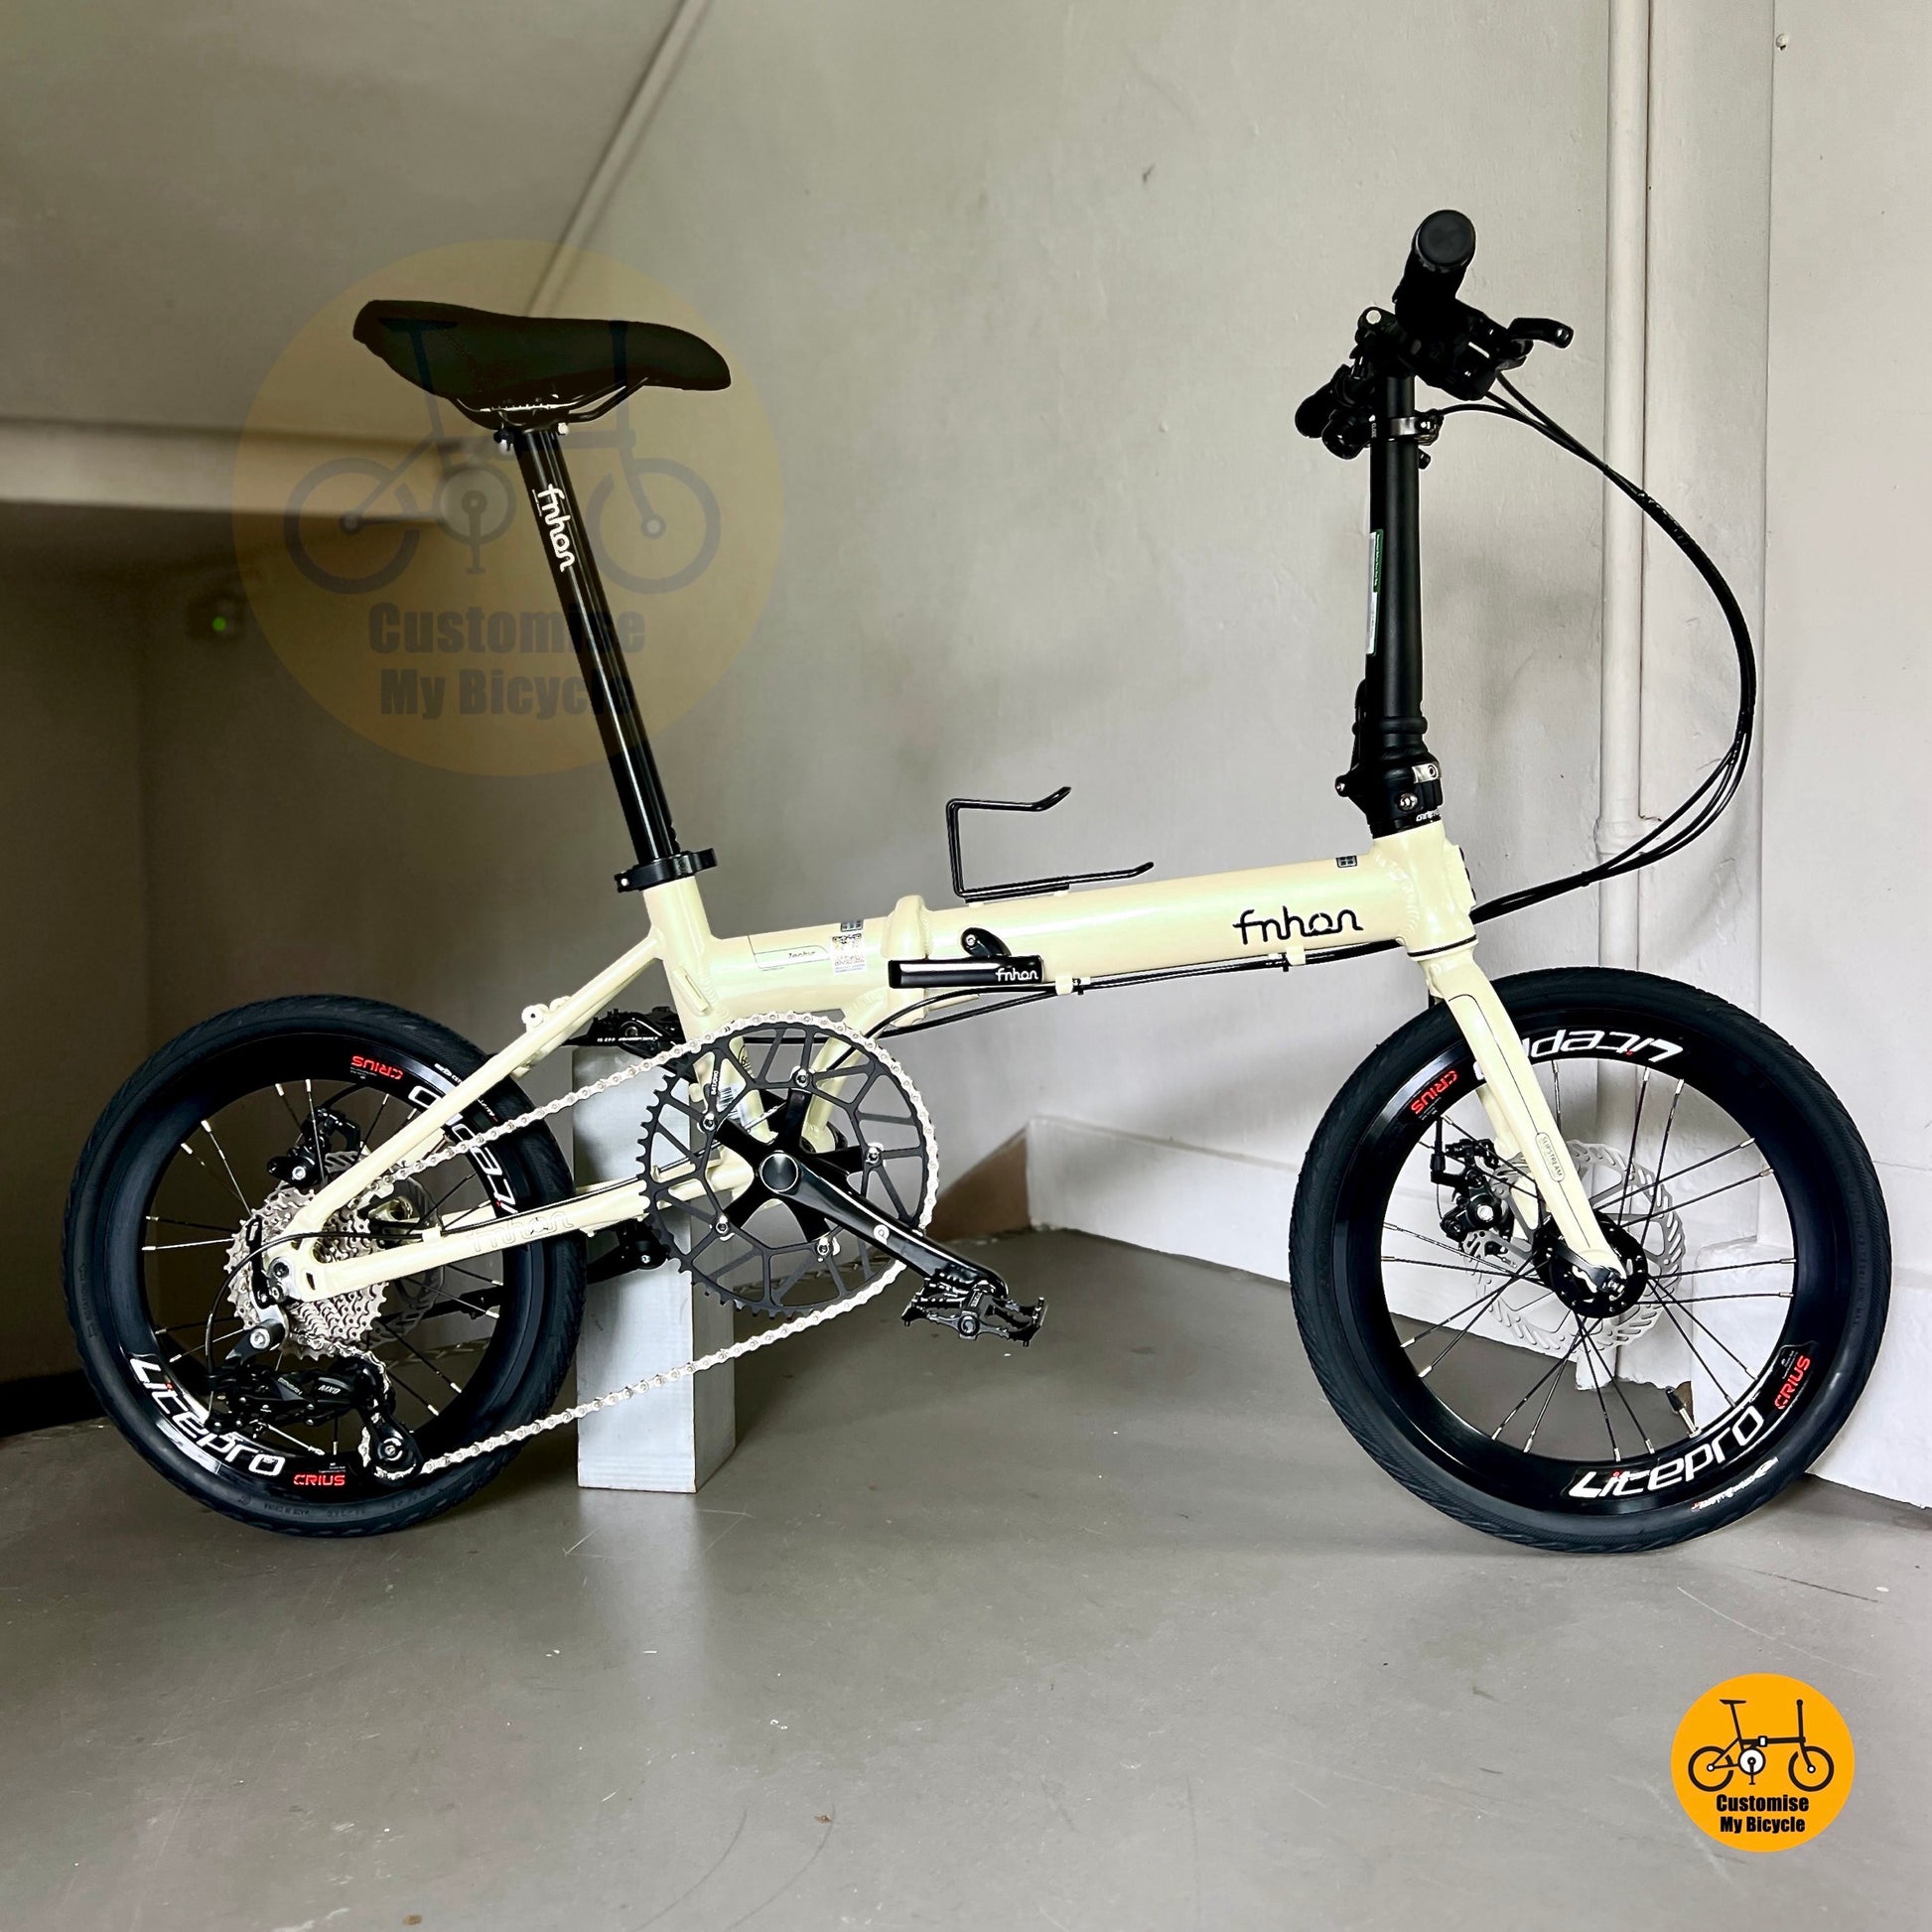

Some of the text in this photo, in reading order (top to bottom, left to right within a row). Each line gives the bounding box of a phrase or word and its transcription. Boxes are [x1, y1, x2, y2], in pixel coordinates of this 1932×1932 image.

[1233, 905, 1364, 945] fnhon
[351, 1055, 404, 1081] CRIUS
[1411, 1070, 1457, 1115] CRIUS
[1774, 1355, 1811, 1410] CRIUS
[293, 1473, 345, 1487] CRIUS
